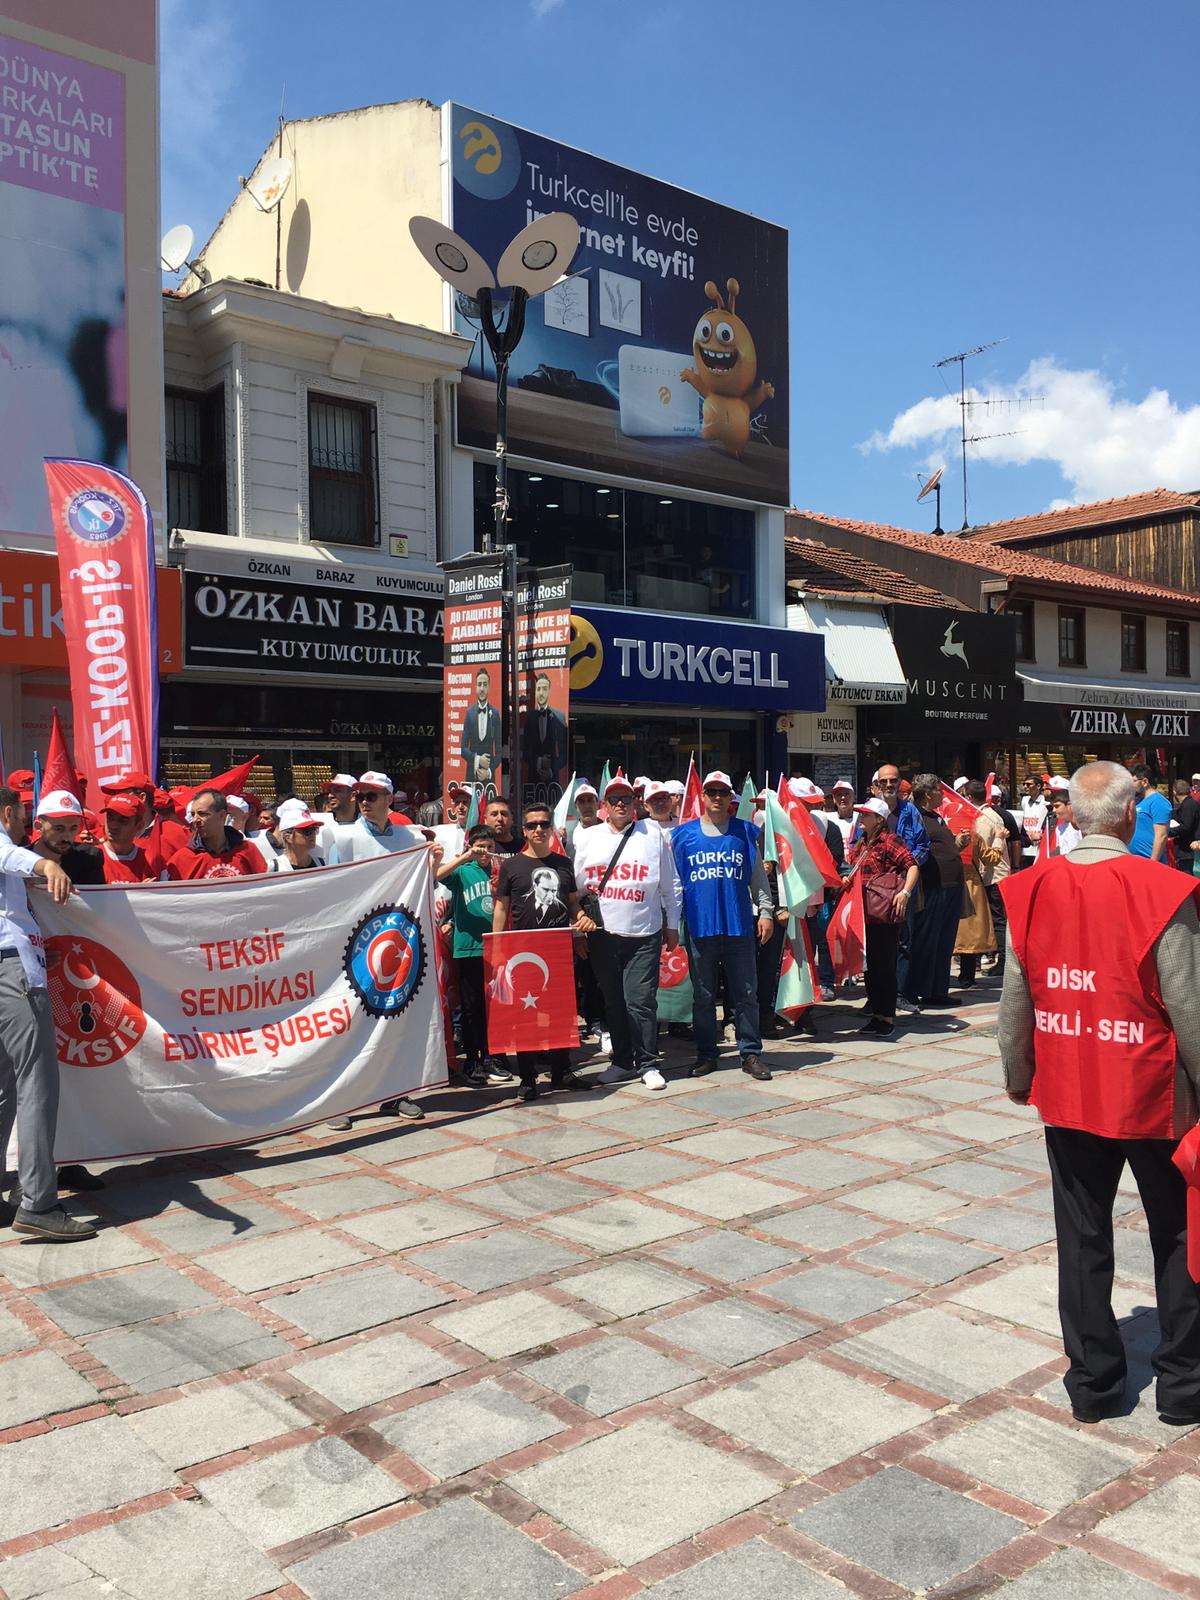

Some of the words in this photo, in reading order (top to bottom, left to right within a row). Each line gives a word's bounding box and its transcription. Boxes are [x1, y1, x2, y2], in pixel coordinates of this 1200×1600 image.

[0, 55, 84, 103] DÜNYA
[2, 86, 113, 138] RKALARI
[0, 112, 91, 159] TASUN
[0, 141, 99, 189] PTİK'TE
[526, 161, 639, 226] Turkcell'le
[646, 214, 699, 247] evde
[526, 199, 625, 258] irnet
[632, 235, 695, 281] keyfi!
[248, 559, 291, 577] ÖZKAN
[316, 569, 355, 584] BARAZ
[376, 575, 444, 594] KUYUMCULU
[448, 575, 476, 594] Daniel
[478, 571, 502, 590] Rossi
[538, 581, 566, 600] Rossi
[0, 583, 65, 638] tik
[194, 575, 342, 628] ÖZKAN
[354, 601, 444, 637] BARA
[163, 650, 172, 663] 2
[260, 638, 422, 667] KUYUMCULUK
[613, 638, 789, 689] TURKCELL
[831, 687, 872, 700] KUYUMCU
[874, 689, 903, 702] ERKAN
[906, 678, 1007, 700] MUSCENT
[1080, 690, 1109, 704] Zehra
[329, 719, 382, 736] ÖZKAN
[387, 722, 436, 737] BARAZ
[817, 718, 854, 730] KUYUMCU
[925, 710, 959, 719] BOUTIQUE
[960, 711, 989, 720] PERFUME
[1070, 710, 1131, 735] ZEHRA
[1151, 711, 1190, 737] ZEKİ
[820, 732, 851, 743] ERKAN
[687, 849, 744, 867] TÜRK-İŞ
[200, 927, 286, 972] TEKSİF
[181, 970, 316, 1018] SENDİKASI
[1047, 963, 1097, 993] DİSK
[56, 1014, 140, 1064] EKSİF
[162, 1024, 256, 1063] EDİRNE
[260, 998, 353, 1059] ŞUBESİ
[1034, 1008, 1081, 1037] EKLİ
[1097, 1018, 1145, 1045] SEN
